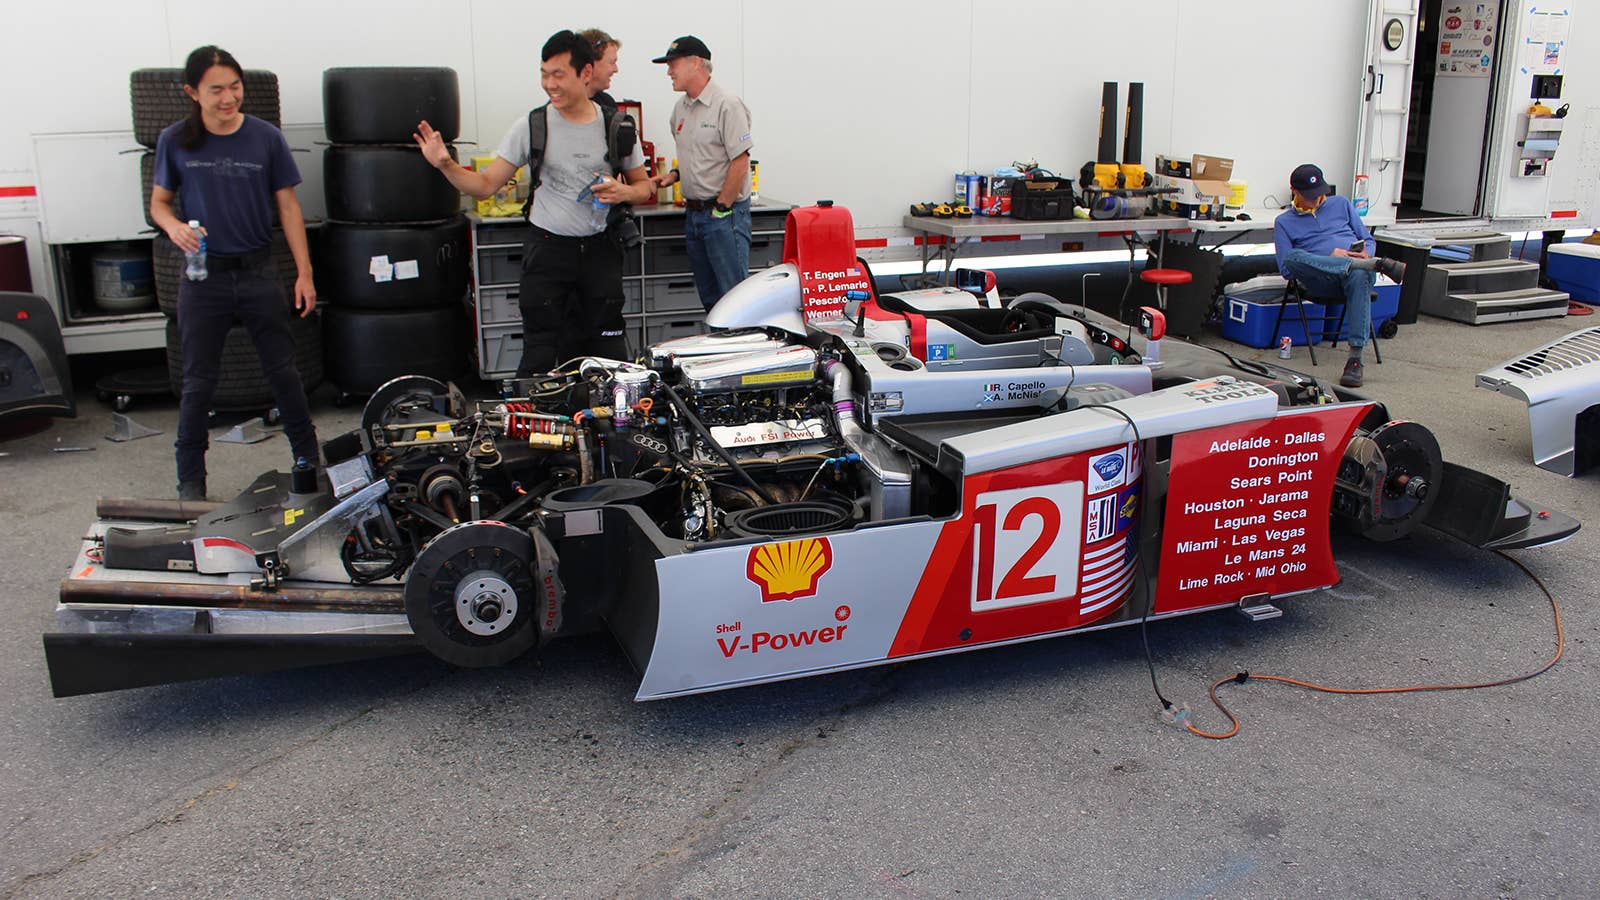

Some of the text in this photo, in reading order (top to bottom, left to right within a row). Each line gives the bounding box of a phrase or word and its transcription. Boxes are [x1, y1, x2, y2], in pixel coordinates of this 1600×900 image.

[803, 271, 846, 281] T. Engen
[818, 284, 827, 292] P.
[829, 281, 868, 292] Lemarie
[809, 295, 848, 306] Pescato
[806, 309, 843, 319] Werner
[993, 381, 1046, 392] R. Capello
[1184, 380, 1255, 397] KLEIN
[1196, 386, 1269, 403] TOOLS
[993, 392, 1004, 401] A.
[734, 435, 755, 443] Audi
[761, 433, 778, 441] FSI
[1208, 432, 1326, 453] Adelaide Dallas
[1248, 451, 1319, 468] Donington
[1230, 469, 1313, 489] Sears Point
[1184, 490, 1309, 514] Houston Jarama
[1088, 502, 1099, 541] IMSA
[1214, 508, 1307, 530] Laguna Seca
[1176, 526, 1306, 553] Miami Las Vegas
[974, 496, 1061, 602] 12
[1224, 543, 1306, 565] Le Mans 24
[1179, 561, 1307, 590] Lime Rock Mid Ohio
[716, 622, 741, 633] Shell
[716, 625, 848, 658] V-Power
